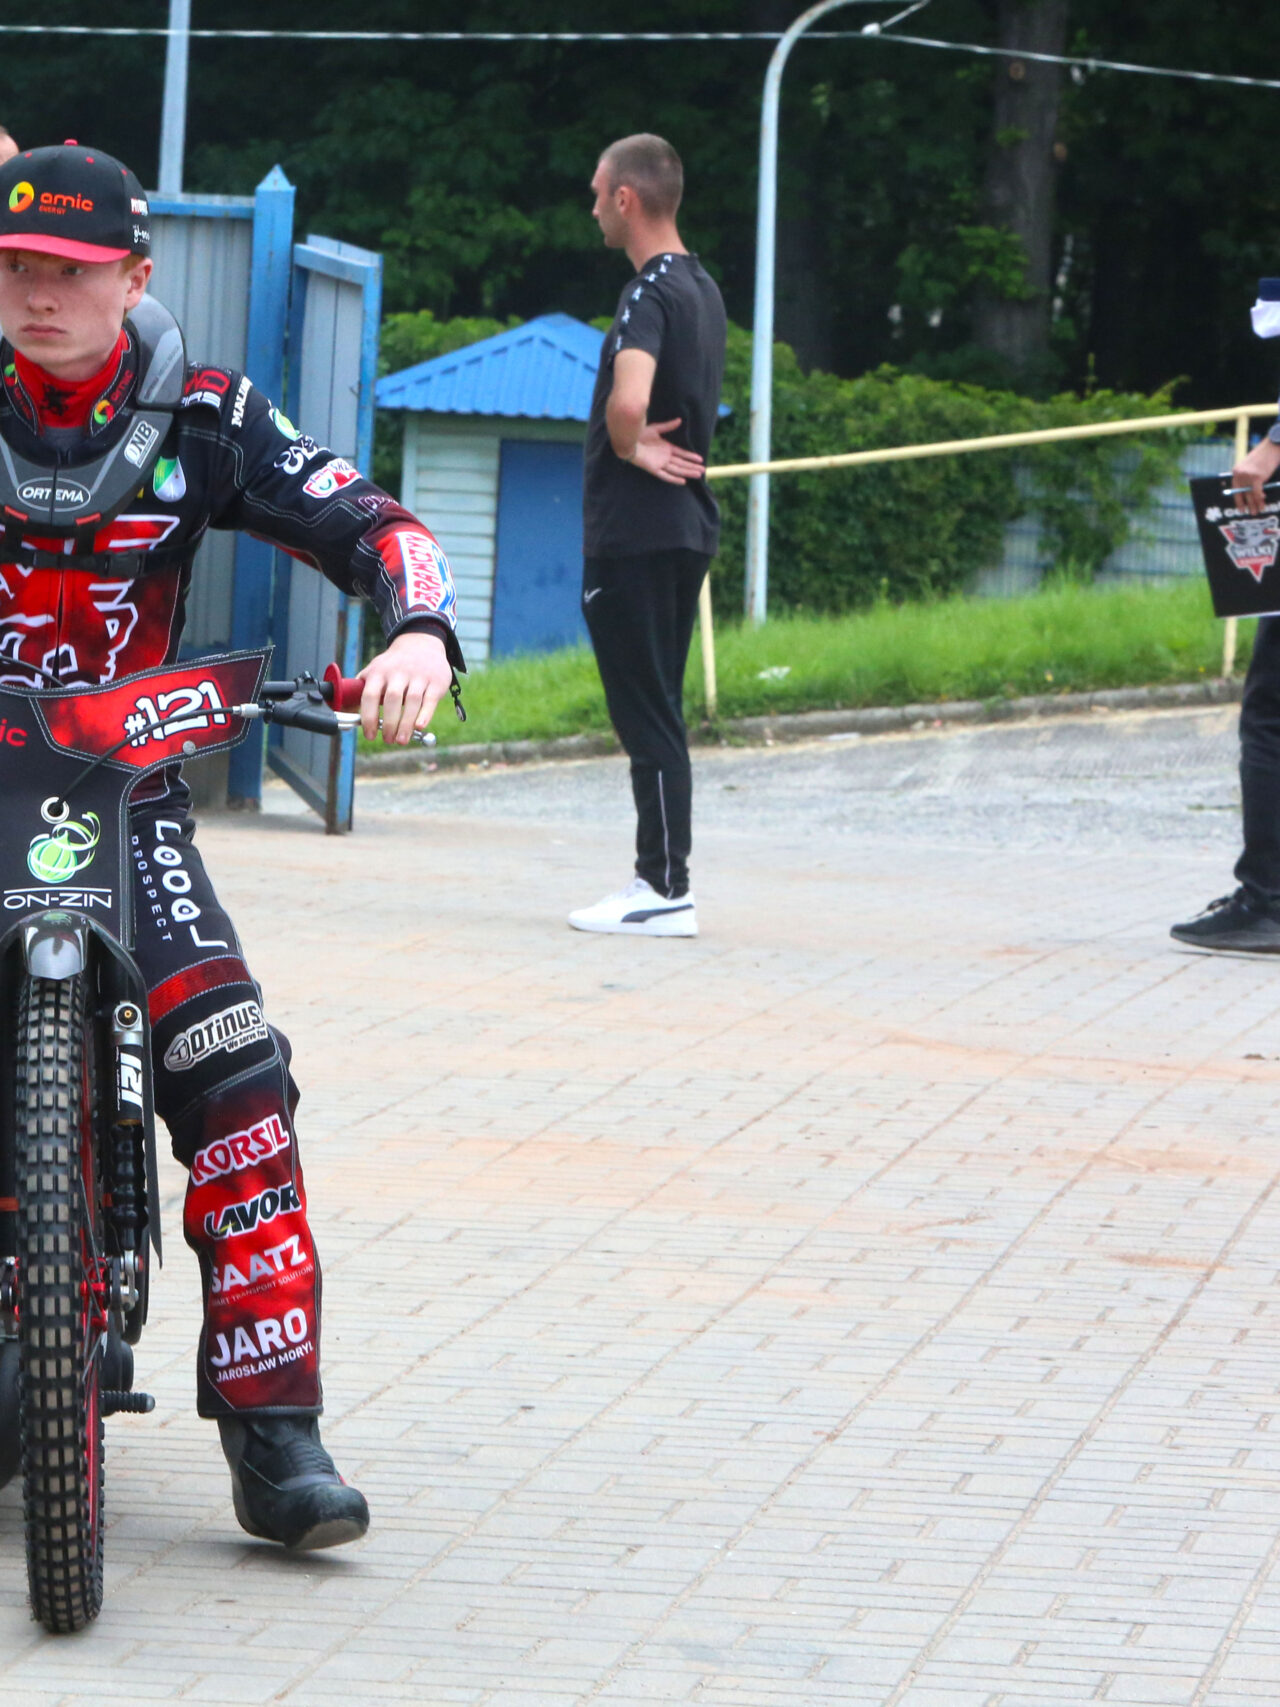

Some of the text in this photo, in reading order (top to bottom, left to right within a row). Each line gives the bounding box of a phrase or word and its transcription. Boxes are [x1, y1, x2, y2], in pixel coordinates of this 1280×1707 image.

[40, 192, 94, 212] amic
[21, 485, 84, 503] ORTEMA
[124, 680, 227, 748] #121
[120, 1052, 142, 1109] 121
[191, 1114, 290, 1186] KORSIL
[211, 1235, 307, 1294] SAATZ
[210, 1307, 308, 1368] JARO
[215, 1359, 278, 1383] JAROSŁAW
